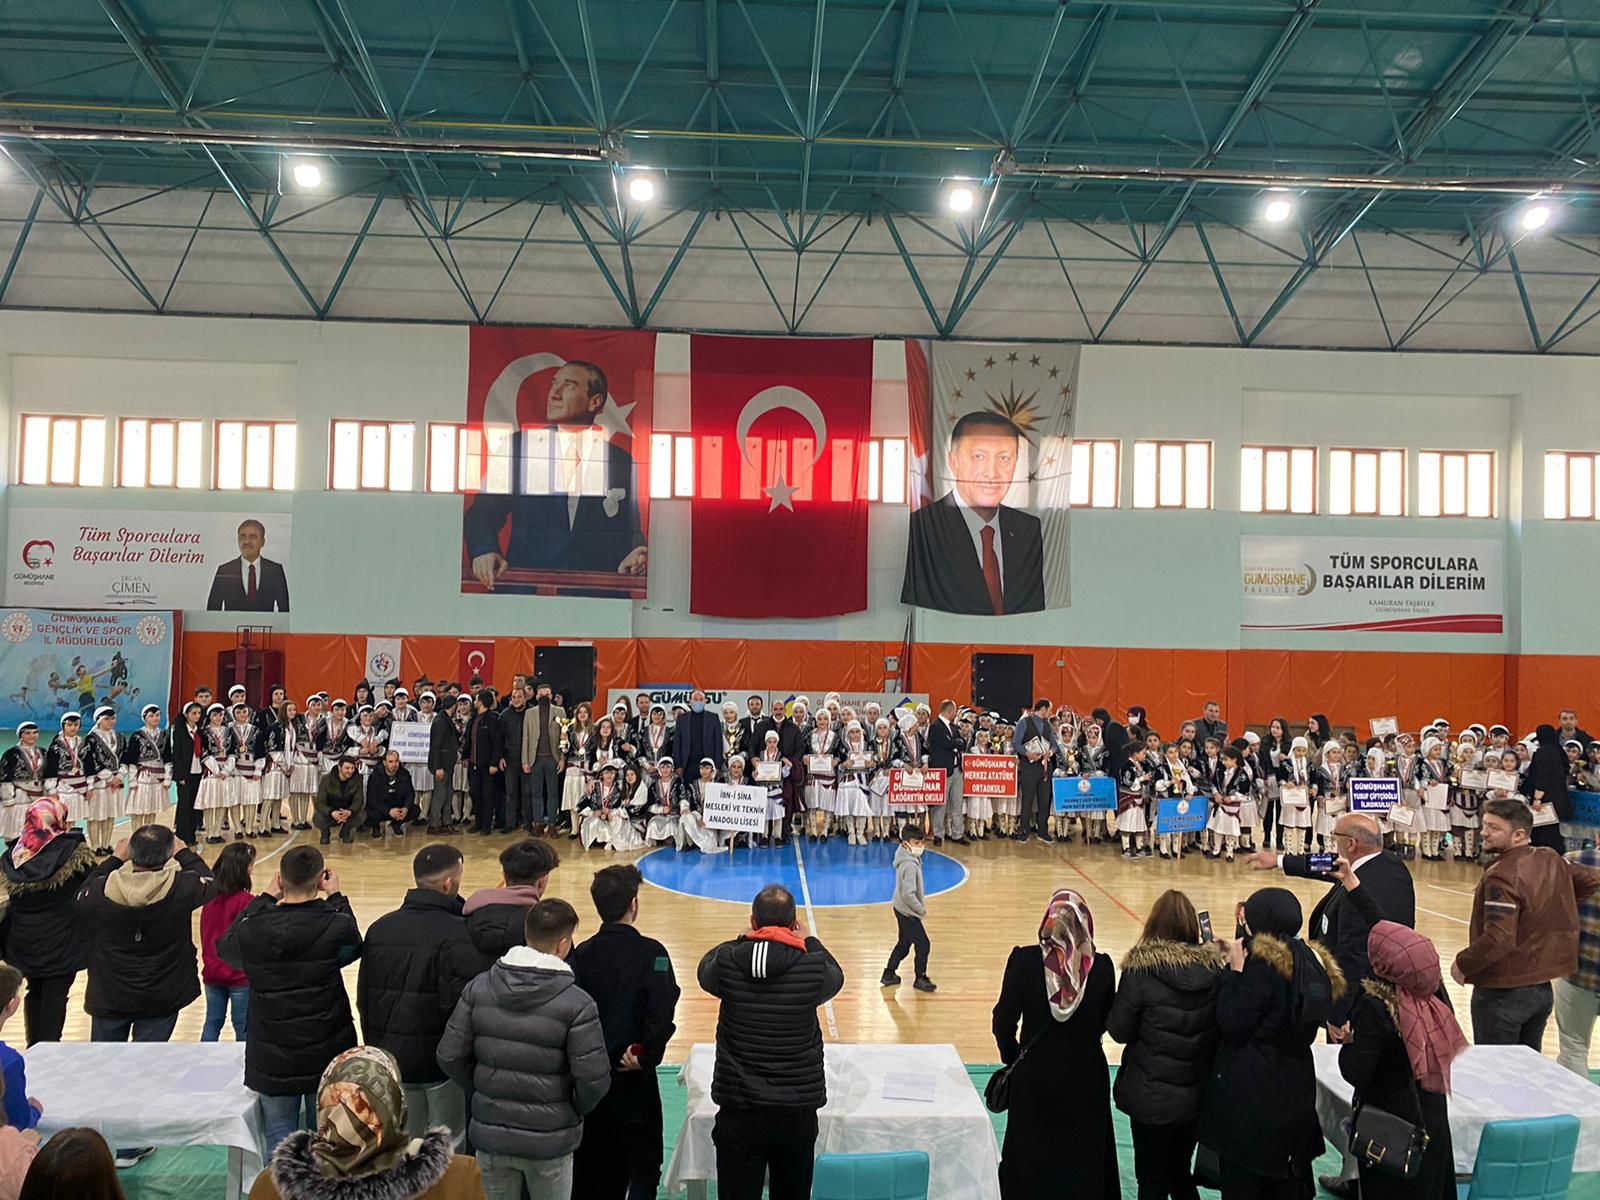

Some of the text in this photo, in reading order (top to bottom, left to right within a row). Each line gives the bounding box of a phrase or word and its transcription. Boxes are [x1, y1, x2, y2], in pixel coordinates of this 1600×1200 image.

[80, 526, 200, 546] Tüm Sporculara
[72, 546, 204, 564] Başarılar Dilerim
[1330, 552, 1478, 571] TÜM SPORCULARA
[112, 580, 151, 594] ÇİMEN
[1322, 573, 1486, 592] BAŞARILAR DİLERİM
[38, 624, 132, 635] GENÇLİK VE SPOR
[651, 691, 722, 704] GÜMÜSU
[972, 758, 1007, 768] GÜMÜŞHANE
[964, 770, 1014, 780] MERKEZ ATATÜRK
[972, 784, 1006, 794] ORTAOKULU
[1354, 782, 1395, 791] GÜMÜŞHANE
[720, 789, 752, 800] İBN-İ SİNA
[924, 794, 944, 802] OKULU
[705, 802, 764, 814] MESLEKİ VE TEKNİK
[1360, 800, 1390, 808] İLKOKULU
[708, 815, 759, 826] ANADOLU LİSESİ
